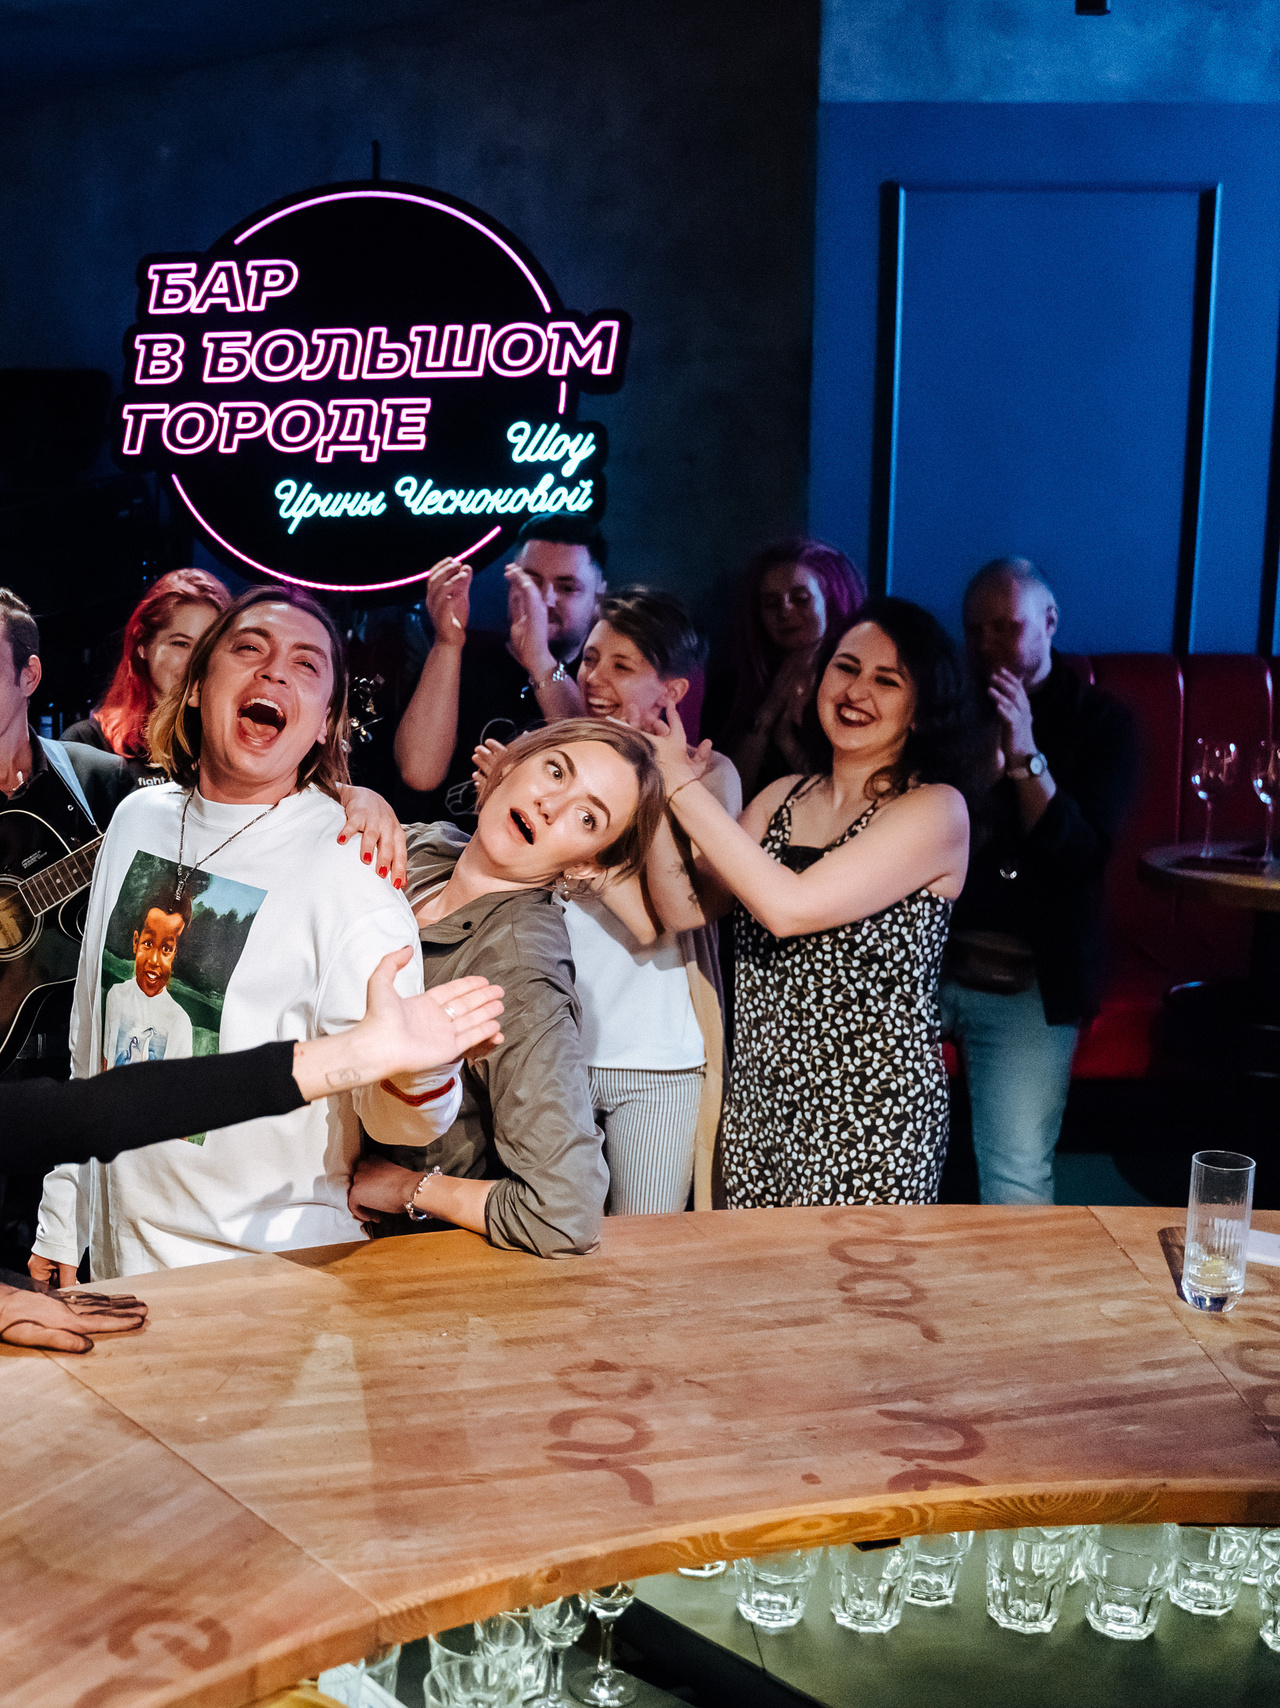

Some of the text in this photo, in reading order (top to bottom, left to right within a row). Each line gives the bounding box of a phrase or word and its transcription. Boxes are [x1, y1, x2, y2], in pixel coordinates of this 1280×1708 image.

[148, 259, 299, 314] БАР
[134, 320, 620, 384] В БОЛЬШОМ
[122, 397, 431, 463] ГОРОДЕ
[506, 421, 596, 477] Шоу
[274, 472, 594, 534] Ирины Чесноковой
